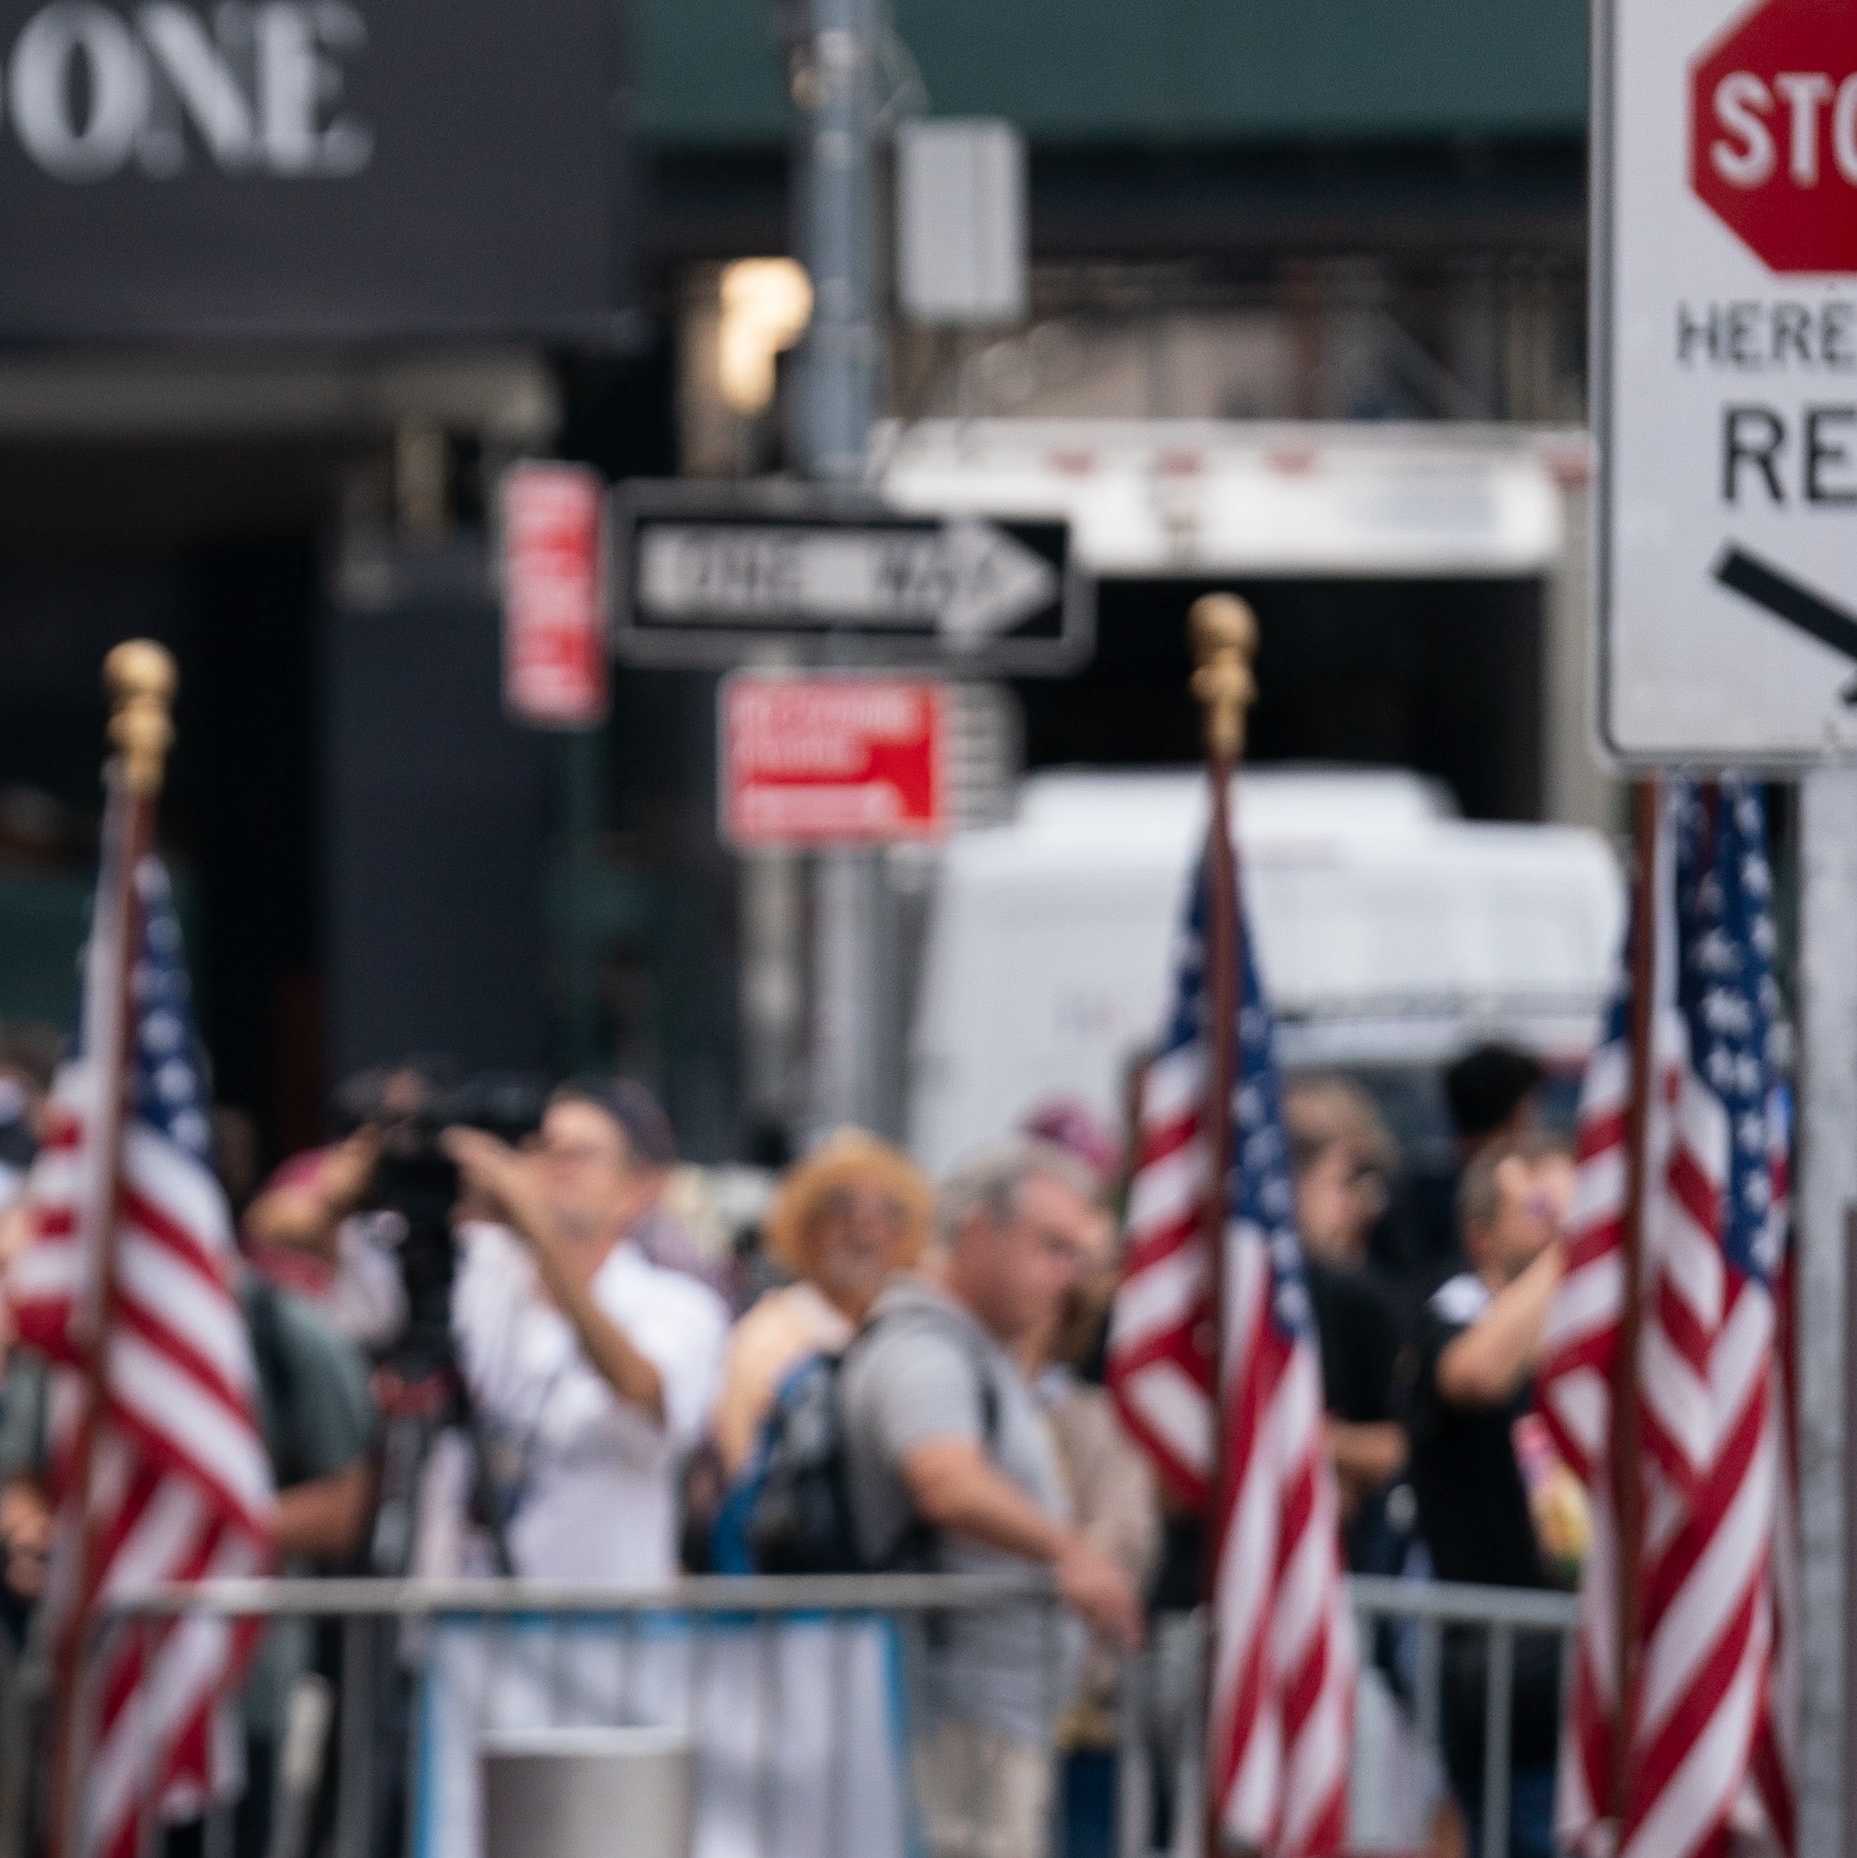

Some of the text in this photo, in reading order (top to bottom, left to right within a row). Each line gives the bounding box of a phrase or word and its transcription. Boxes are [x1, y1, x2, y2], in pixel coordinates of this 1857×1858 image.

[9, 0, 373, 184] ONE
[1679, 303, 1857, 366] HERE
[1722, 408, 1857, 502] RE
[675, 538, 801, 606] ONE
